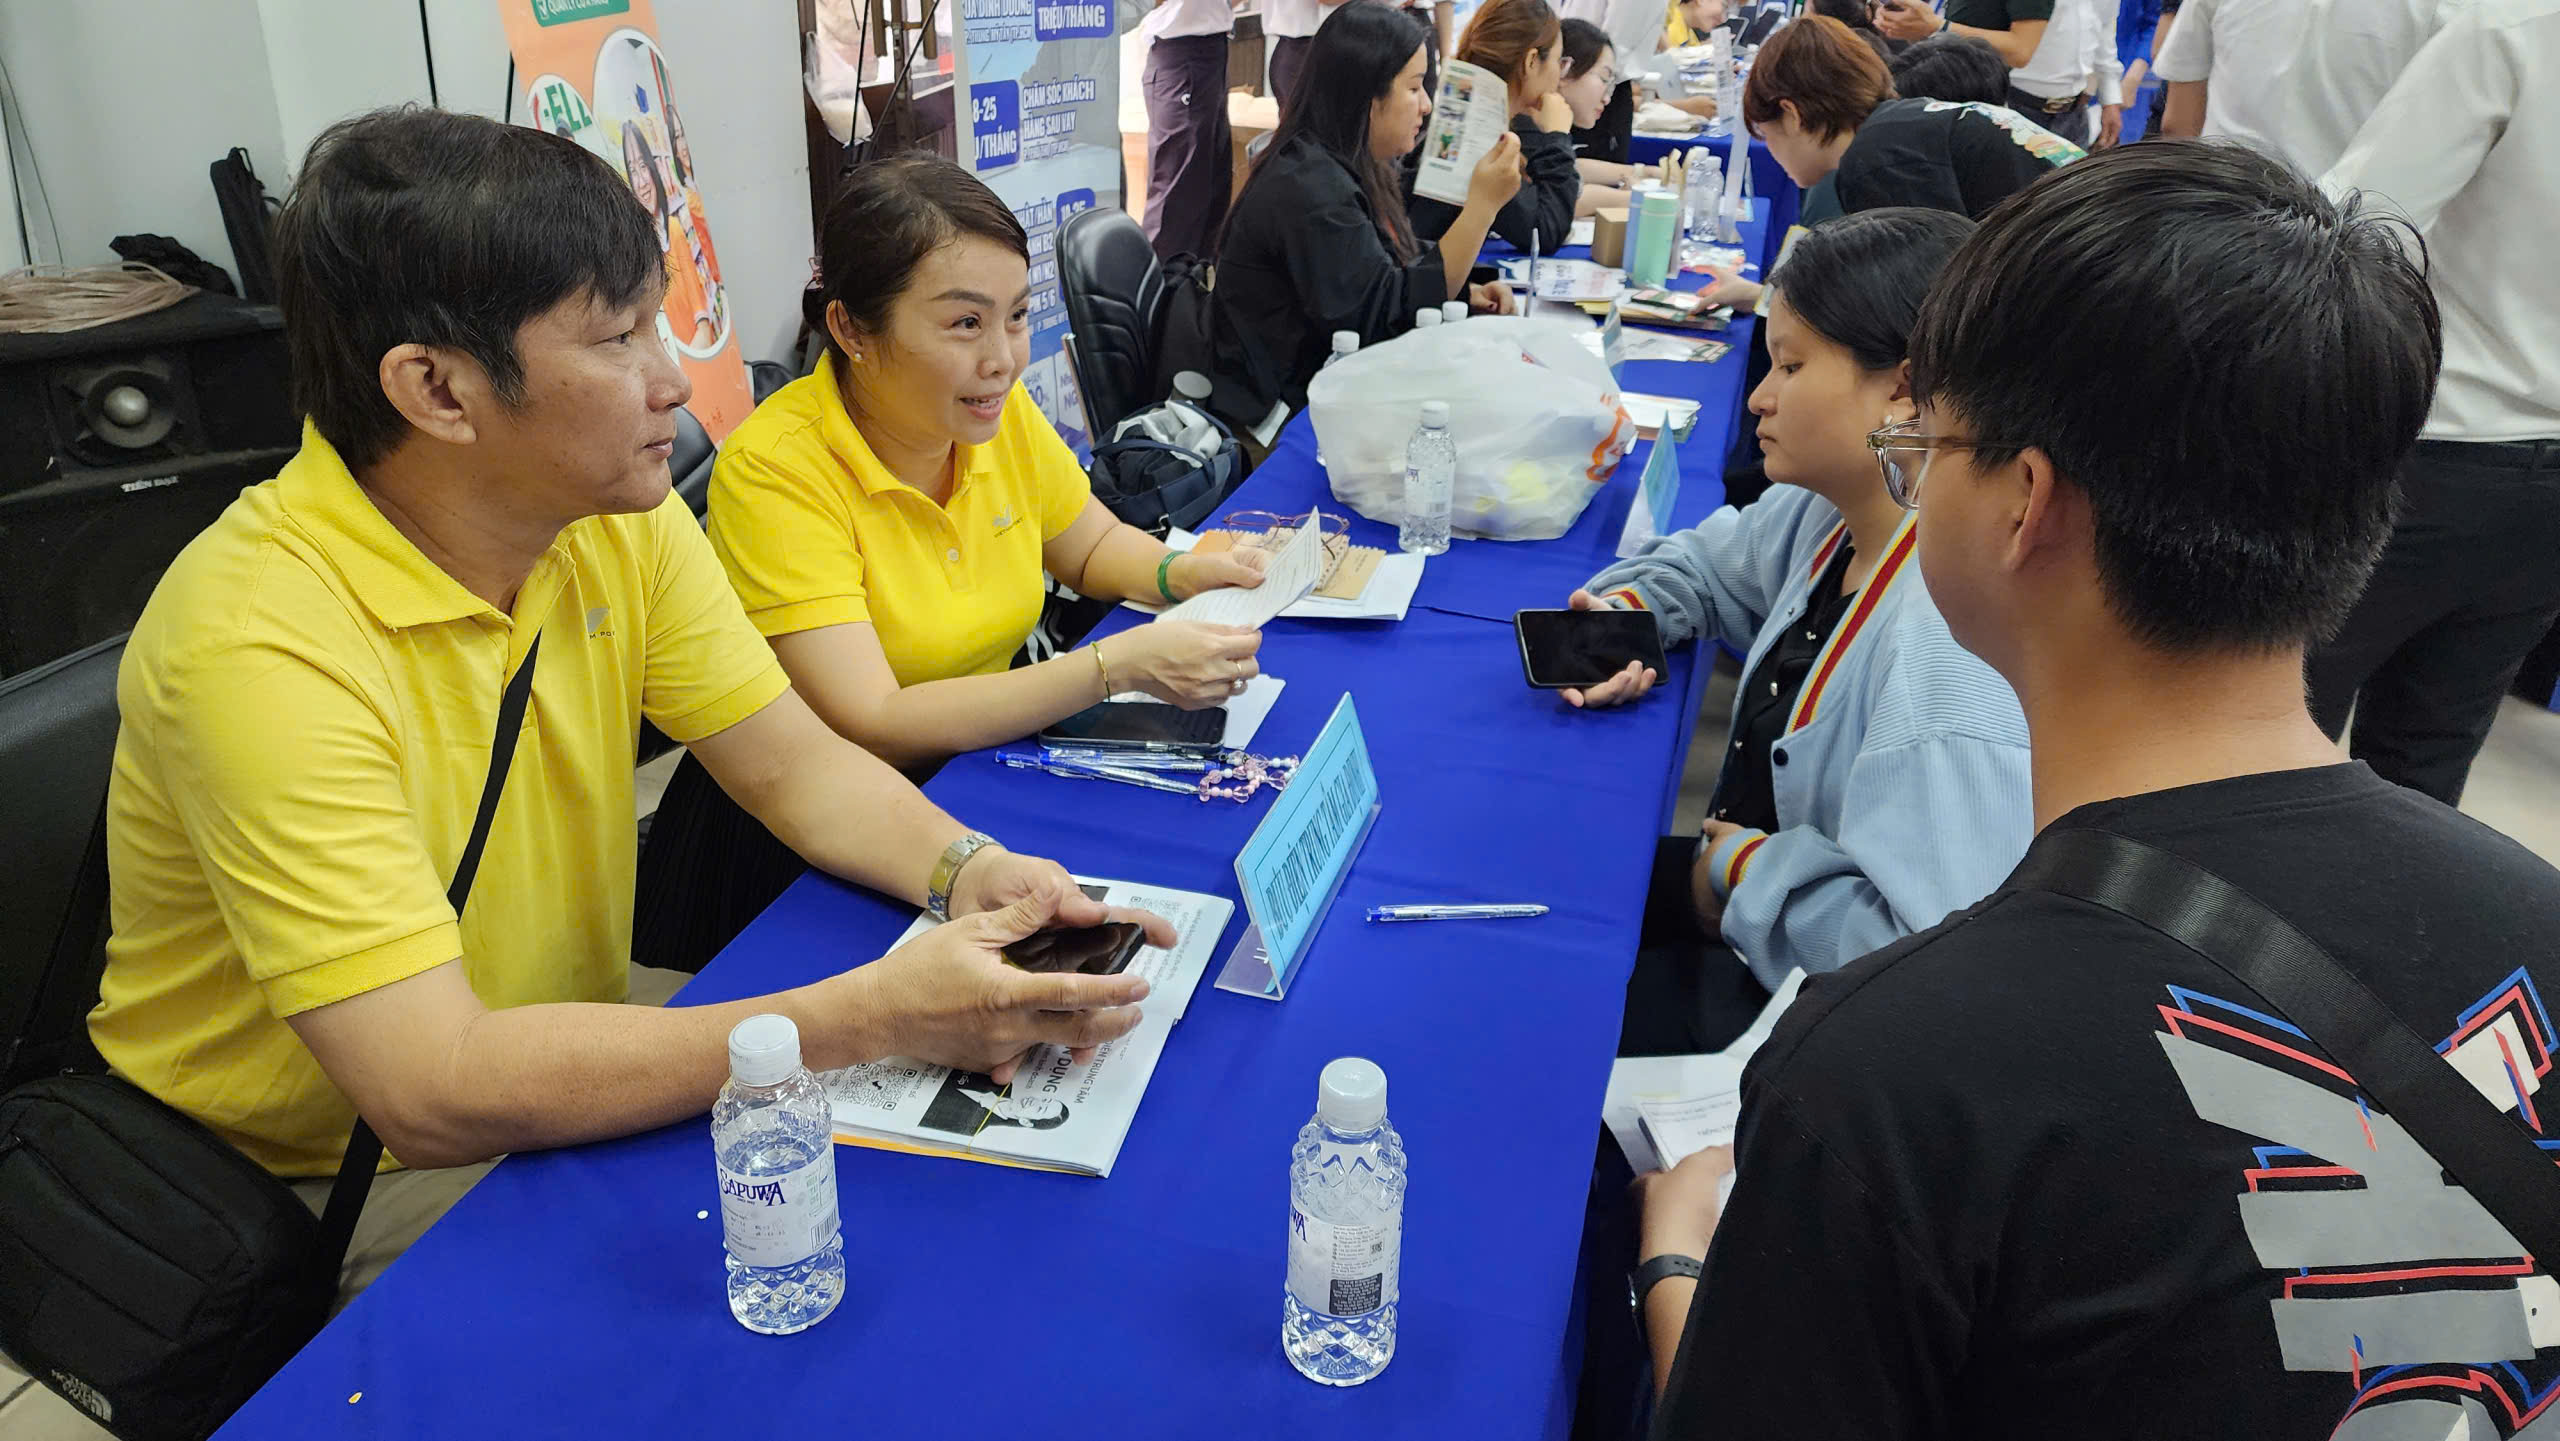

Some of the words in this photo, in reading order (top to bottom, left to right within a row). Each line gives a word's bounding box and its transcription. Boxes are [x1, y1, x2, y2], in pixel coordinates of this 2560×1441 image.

[1037, 0, 1106, 35] TRIỆU/THÁNG
[1023, 80, 1046, 110] CHĂM
[1046, 76, 1061, 106] SÓC
[1061, 74, 1096, 104] KHÁCH
[1023, 111, 1046, 141] HÀNG
[1045, 113, 1061, 137] SAU
[1060, 109, 1077, 134] VAY
[1297, 807, 1332, 887] TRUNG
[1042, 1057, 1073, 1094] DỤNG
[1083, 1058, 1105, 1086] TRUNG
[1073, 1085, 1092, 1105] TÂM
[720, 1167, 787, 1207] SAPUWA
